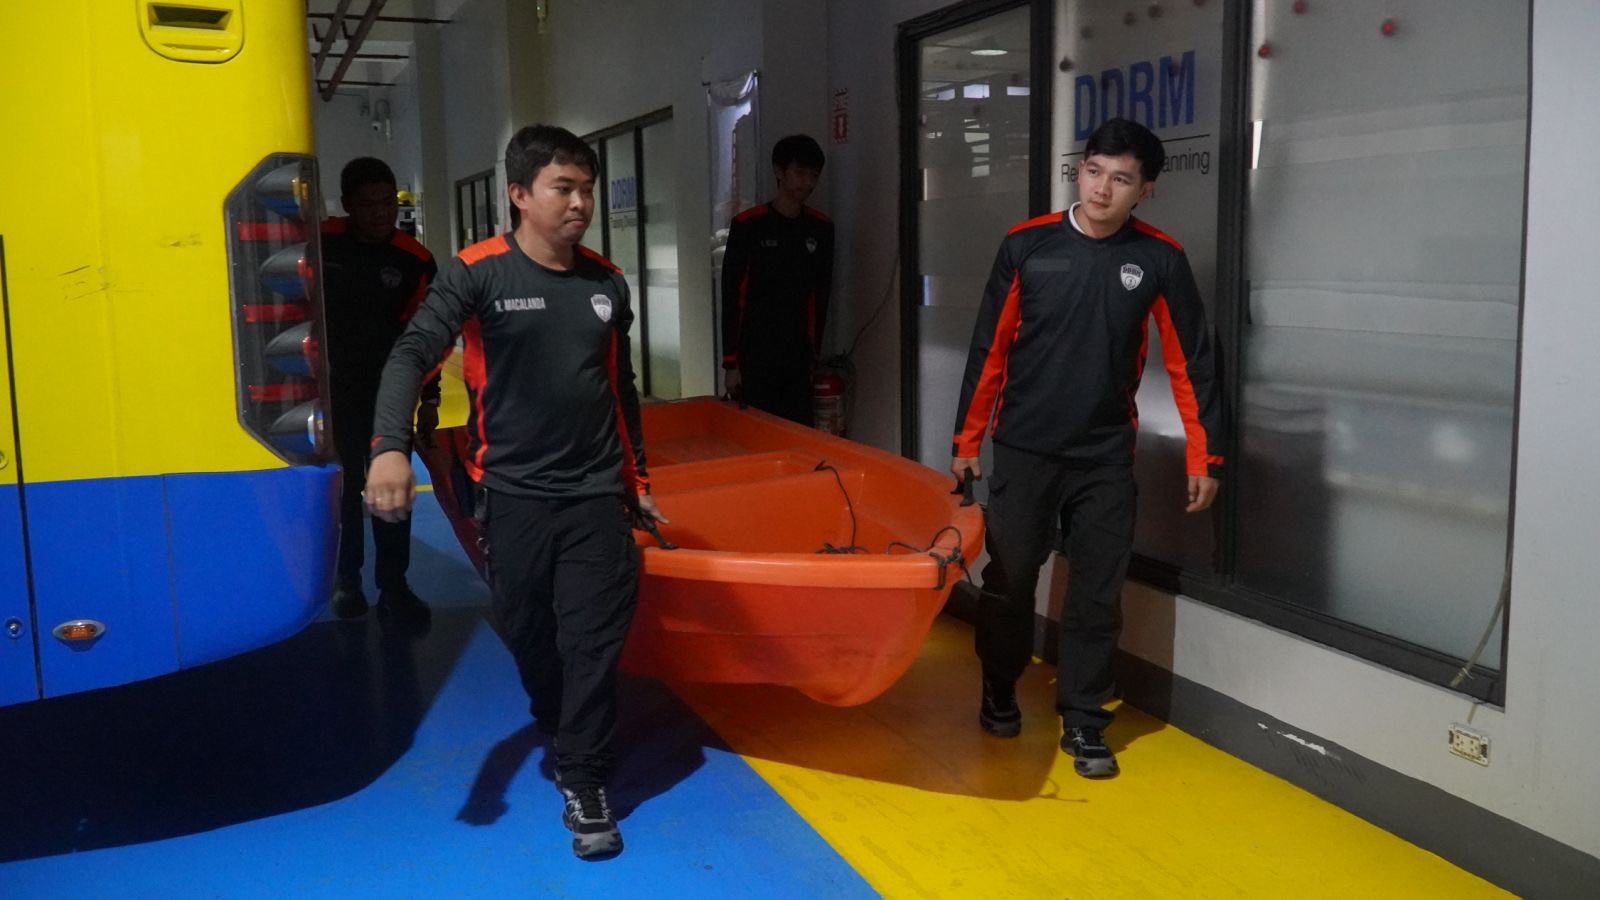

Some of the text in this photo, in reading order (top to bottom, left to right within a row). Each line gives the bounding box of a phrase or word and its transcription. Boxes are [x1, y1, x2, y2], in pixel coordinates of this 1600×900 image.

[1074, 50, 1195, 141] DDRM
[1163, 148, 1210, 174] anning
[504, 297, 546, 311] MACALANDA
